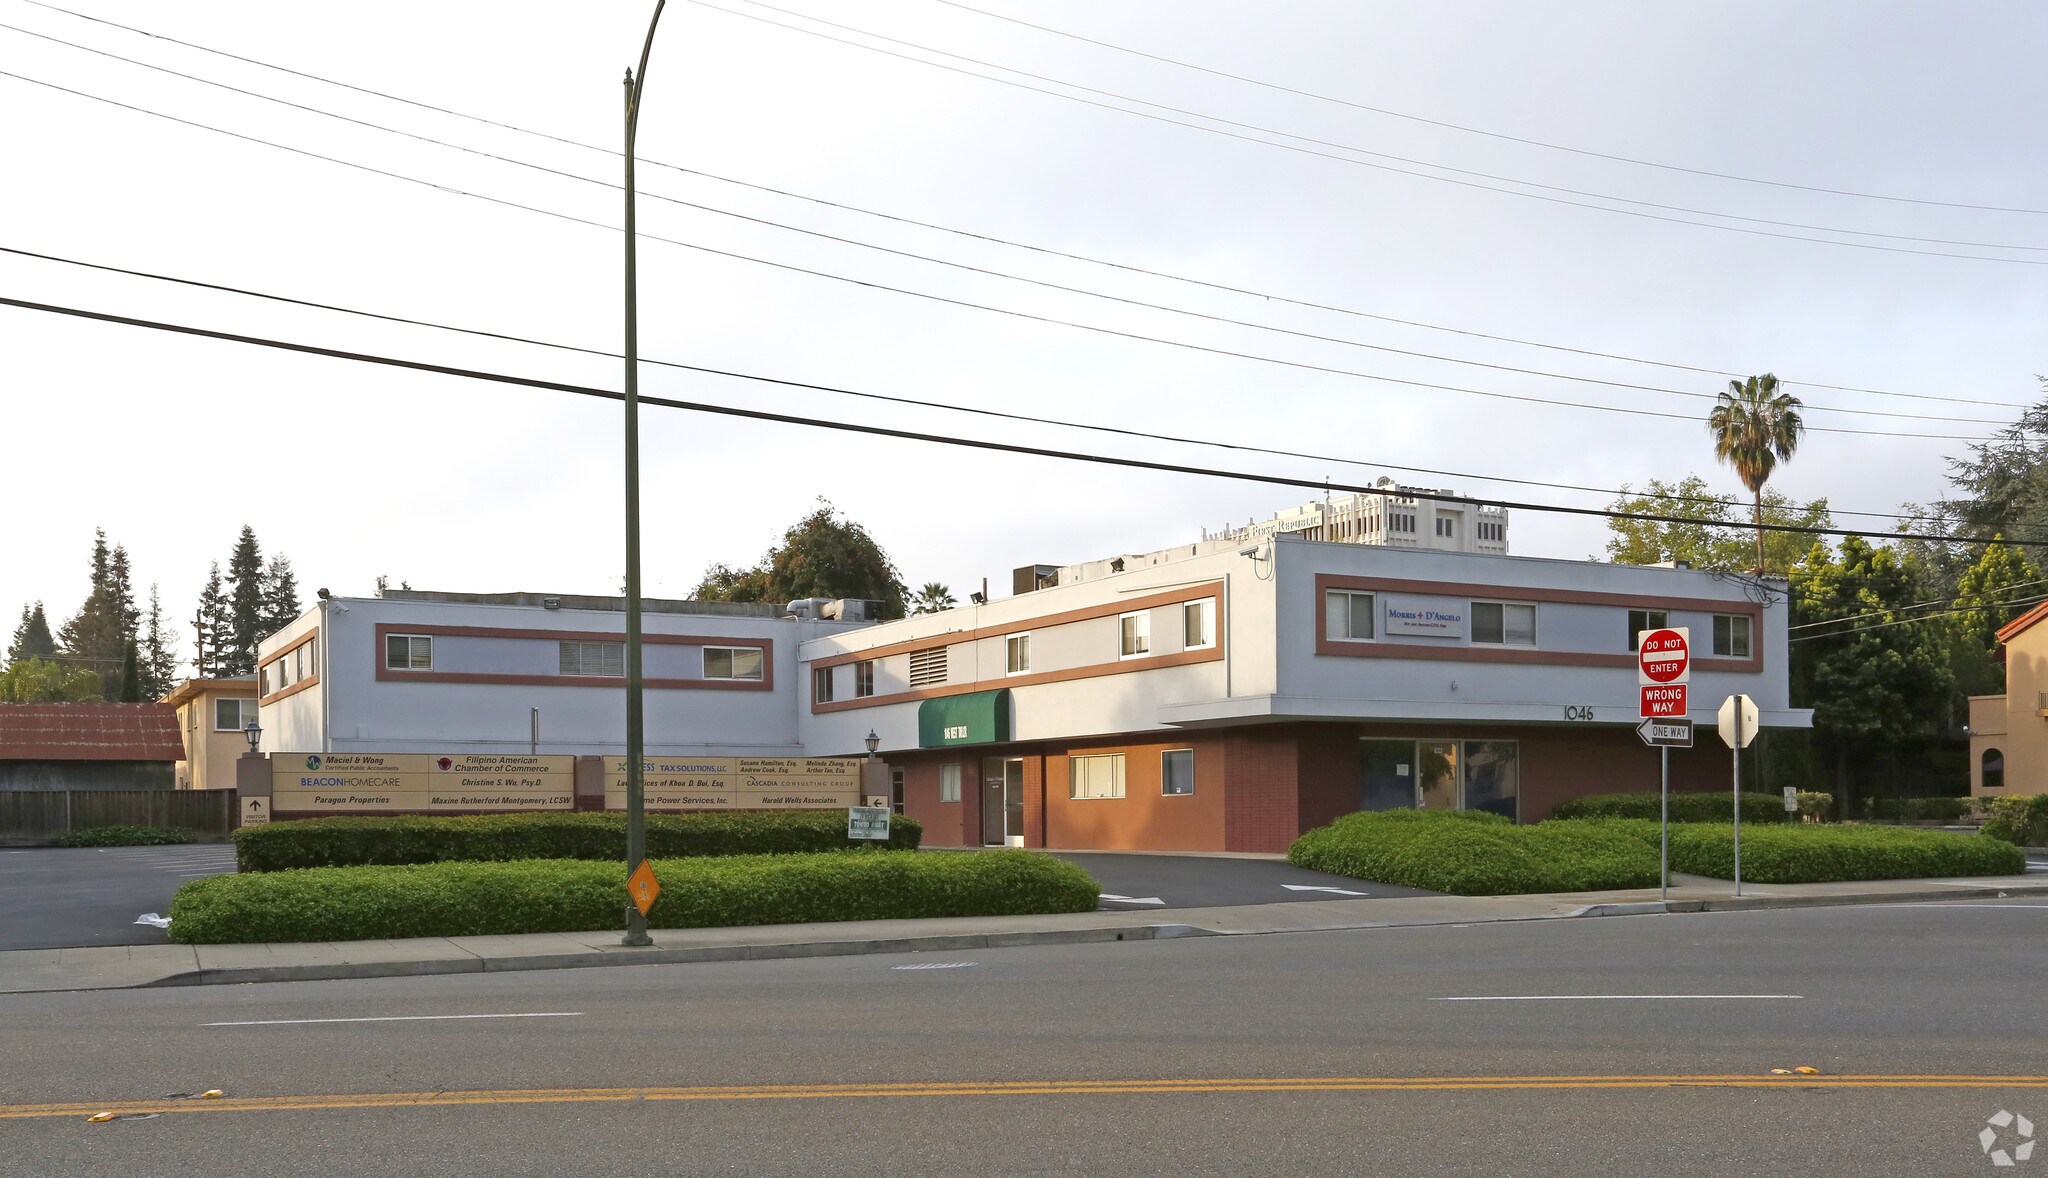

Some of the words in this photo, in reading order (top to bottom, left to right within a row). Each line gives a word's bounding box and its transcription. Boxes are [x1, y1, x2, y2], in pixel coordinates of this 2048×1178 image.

[1278, 516, 1320, 531] REPUBLIC
[1647, 640, 1658, 650] DO
[1664, 639, 1681, 649] NOT
[1650, 664, 1678, 673] ENTER
[1645, 689, 1682, 701] WRONG
[1652, 702, 1675, 713] WAY
[1564, 705, 1594, 720] 1046
[1652, 726, 1668, 737] ONE
[1670, 726, 1686, 738] WAY
[325, 756, 352, 764] Maciel
[355, 756, 361, 764] &
[362, 756, 384, 765] Wong
[466, 756, 496, 765] Filipino
[499, 756, 538, 764] American
[454, 764, 493, 772] Chamber
[494, 764, 503, 772] of
[660, 764, 676, 772] TAX
[505, 779, 519, 787] Wu,
[660, 779, 667, 787] of
[668, 779, 686, 787] Khoa
[314, 796, 346, 805] Paragon
[349, 796, 390, 805] Properties
[431, 797, 459, 805] Maxine
[460, 796, 500, 804] Rutherford
[657, 796, 680, 804] Power
